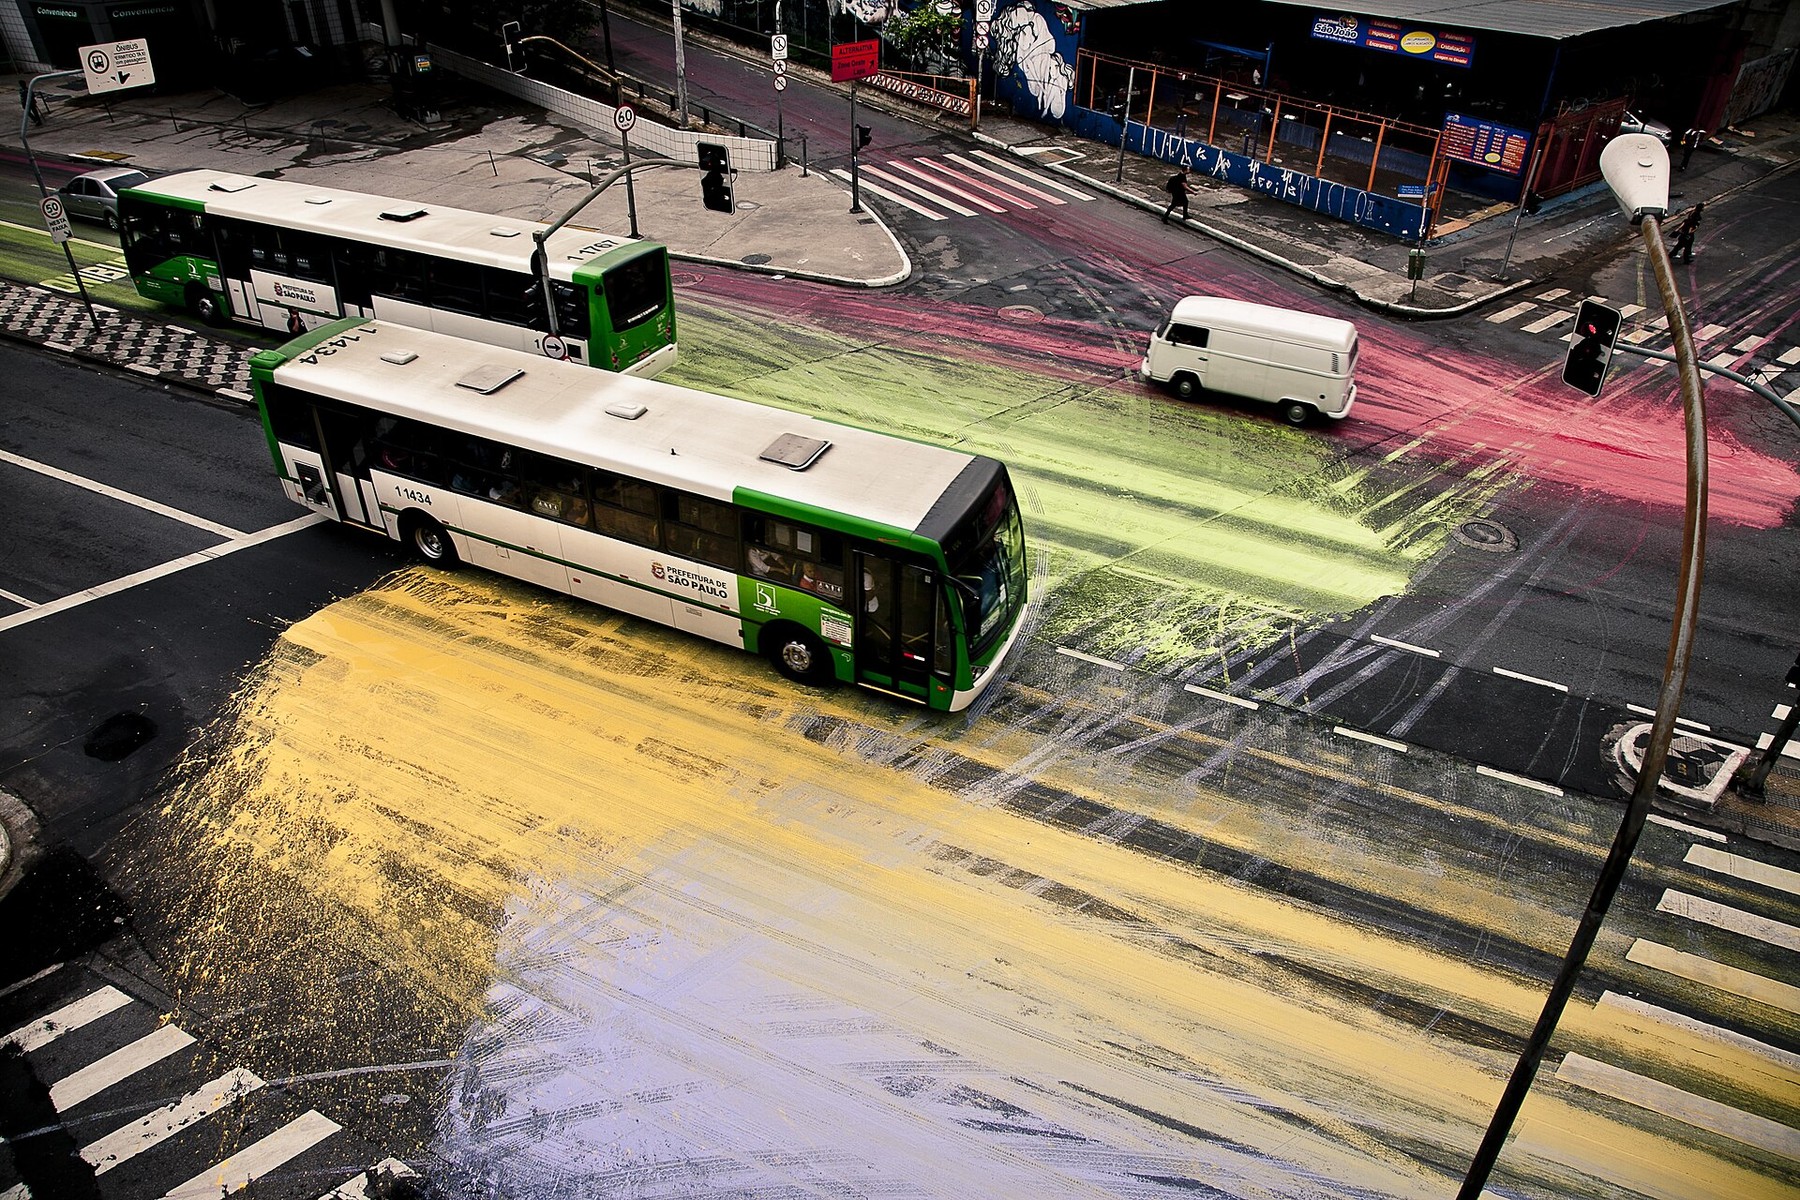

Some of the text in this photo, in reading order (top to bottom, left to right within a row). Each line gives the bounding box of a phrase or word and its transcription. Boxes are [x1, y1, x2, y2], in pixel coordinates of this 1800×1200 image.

[1314, 23, 1333, 34] São
[1333, 26, 1358, 39] João
[618, 109, 632, 123] 60
[45, 202, 59, 214] 50
[49, 218, 67, 226] NESTA
[52, 224, 69, 232] FAIXA
[579, 239, 619, 254] 1767
[296, 293, 316, 304] PAULO
[299, 335, 360, 365] 1434
[403, 488, 432, 506] 1434
[666, 565, 727, 590] PREFEITURA DE
[667, 574, 728, 599] SÃO PAULO
